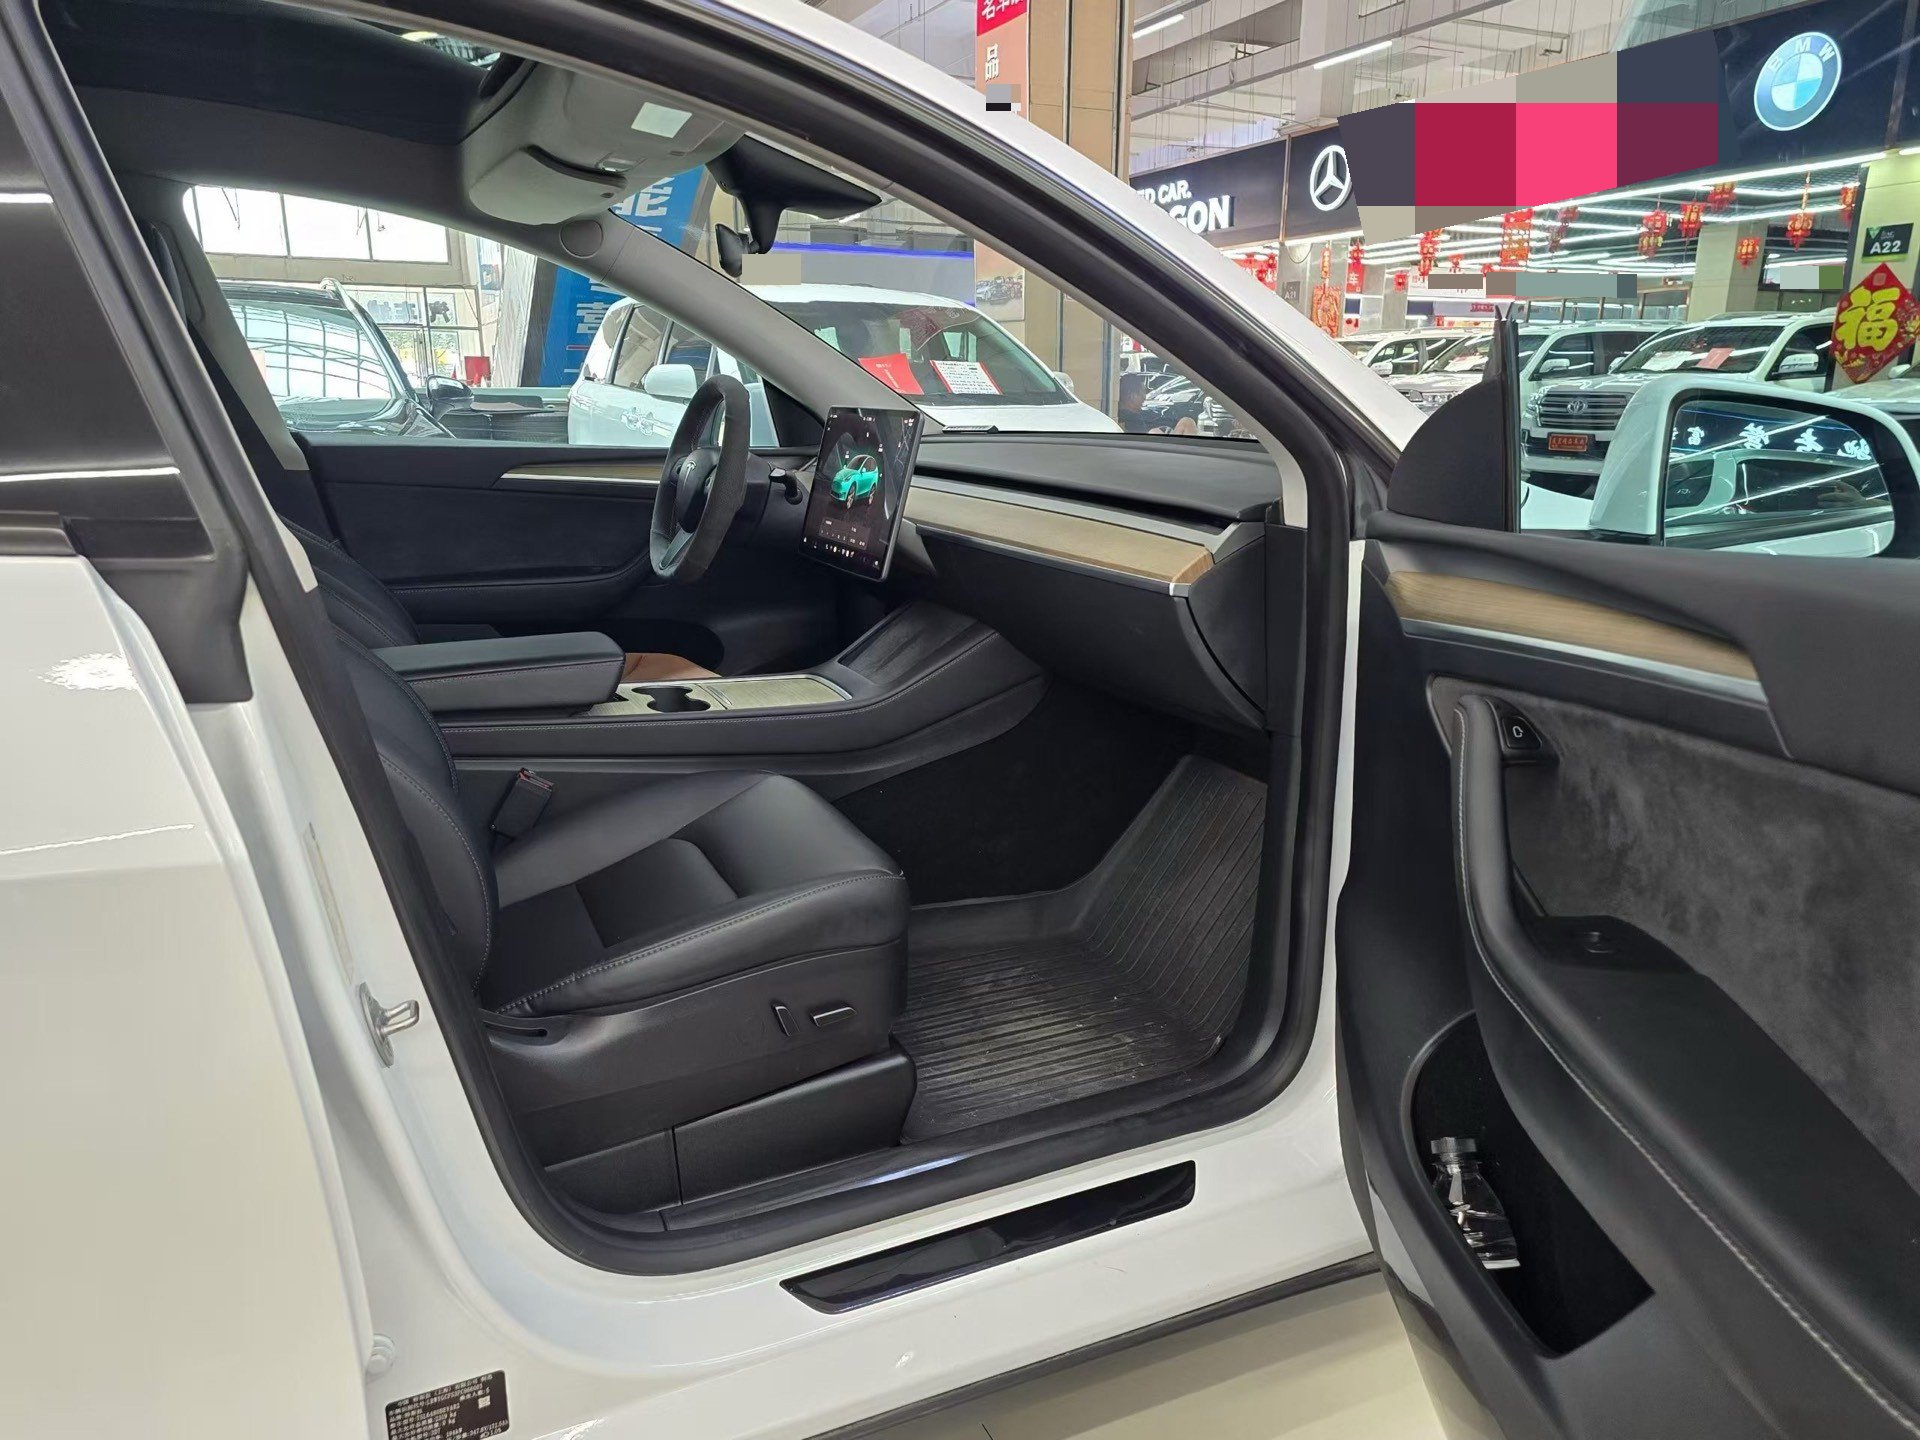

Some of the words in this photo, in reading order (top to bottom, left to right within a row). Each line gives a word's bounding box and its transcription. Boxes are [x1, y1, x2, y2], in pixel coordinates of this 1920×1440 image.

[1767, 36, 1836, 73] BMW
[1158, 179, 1193, 204] CAR.
[1869, 240, 1902, 254] A22
[1835, 286, 1901, 351] 福
